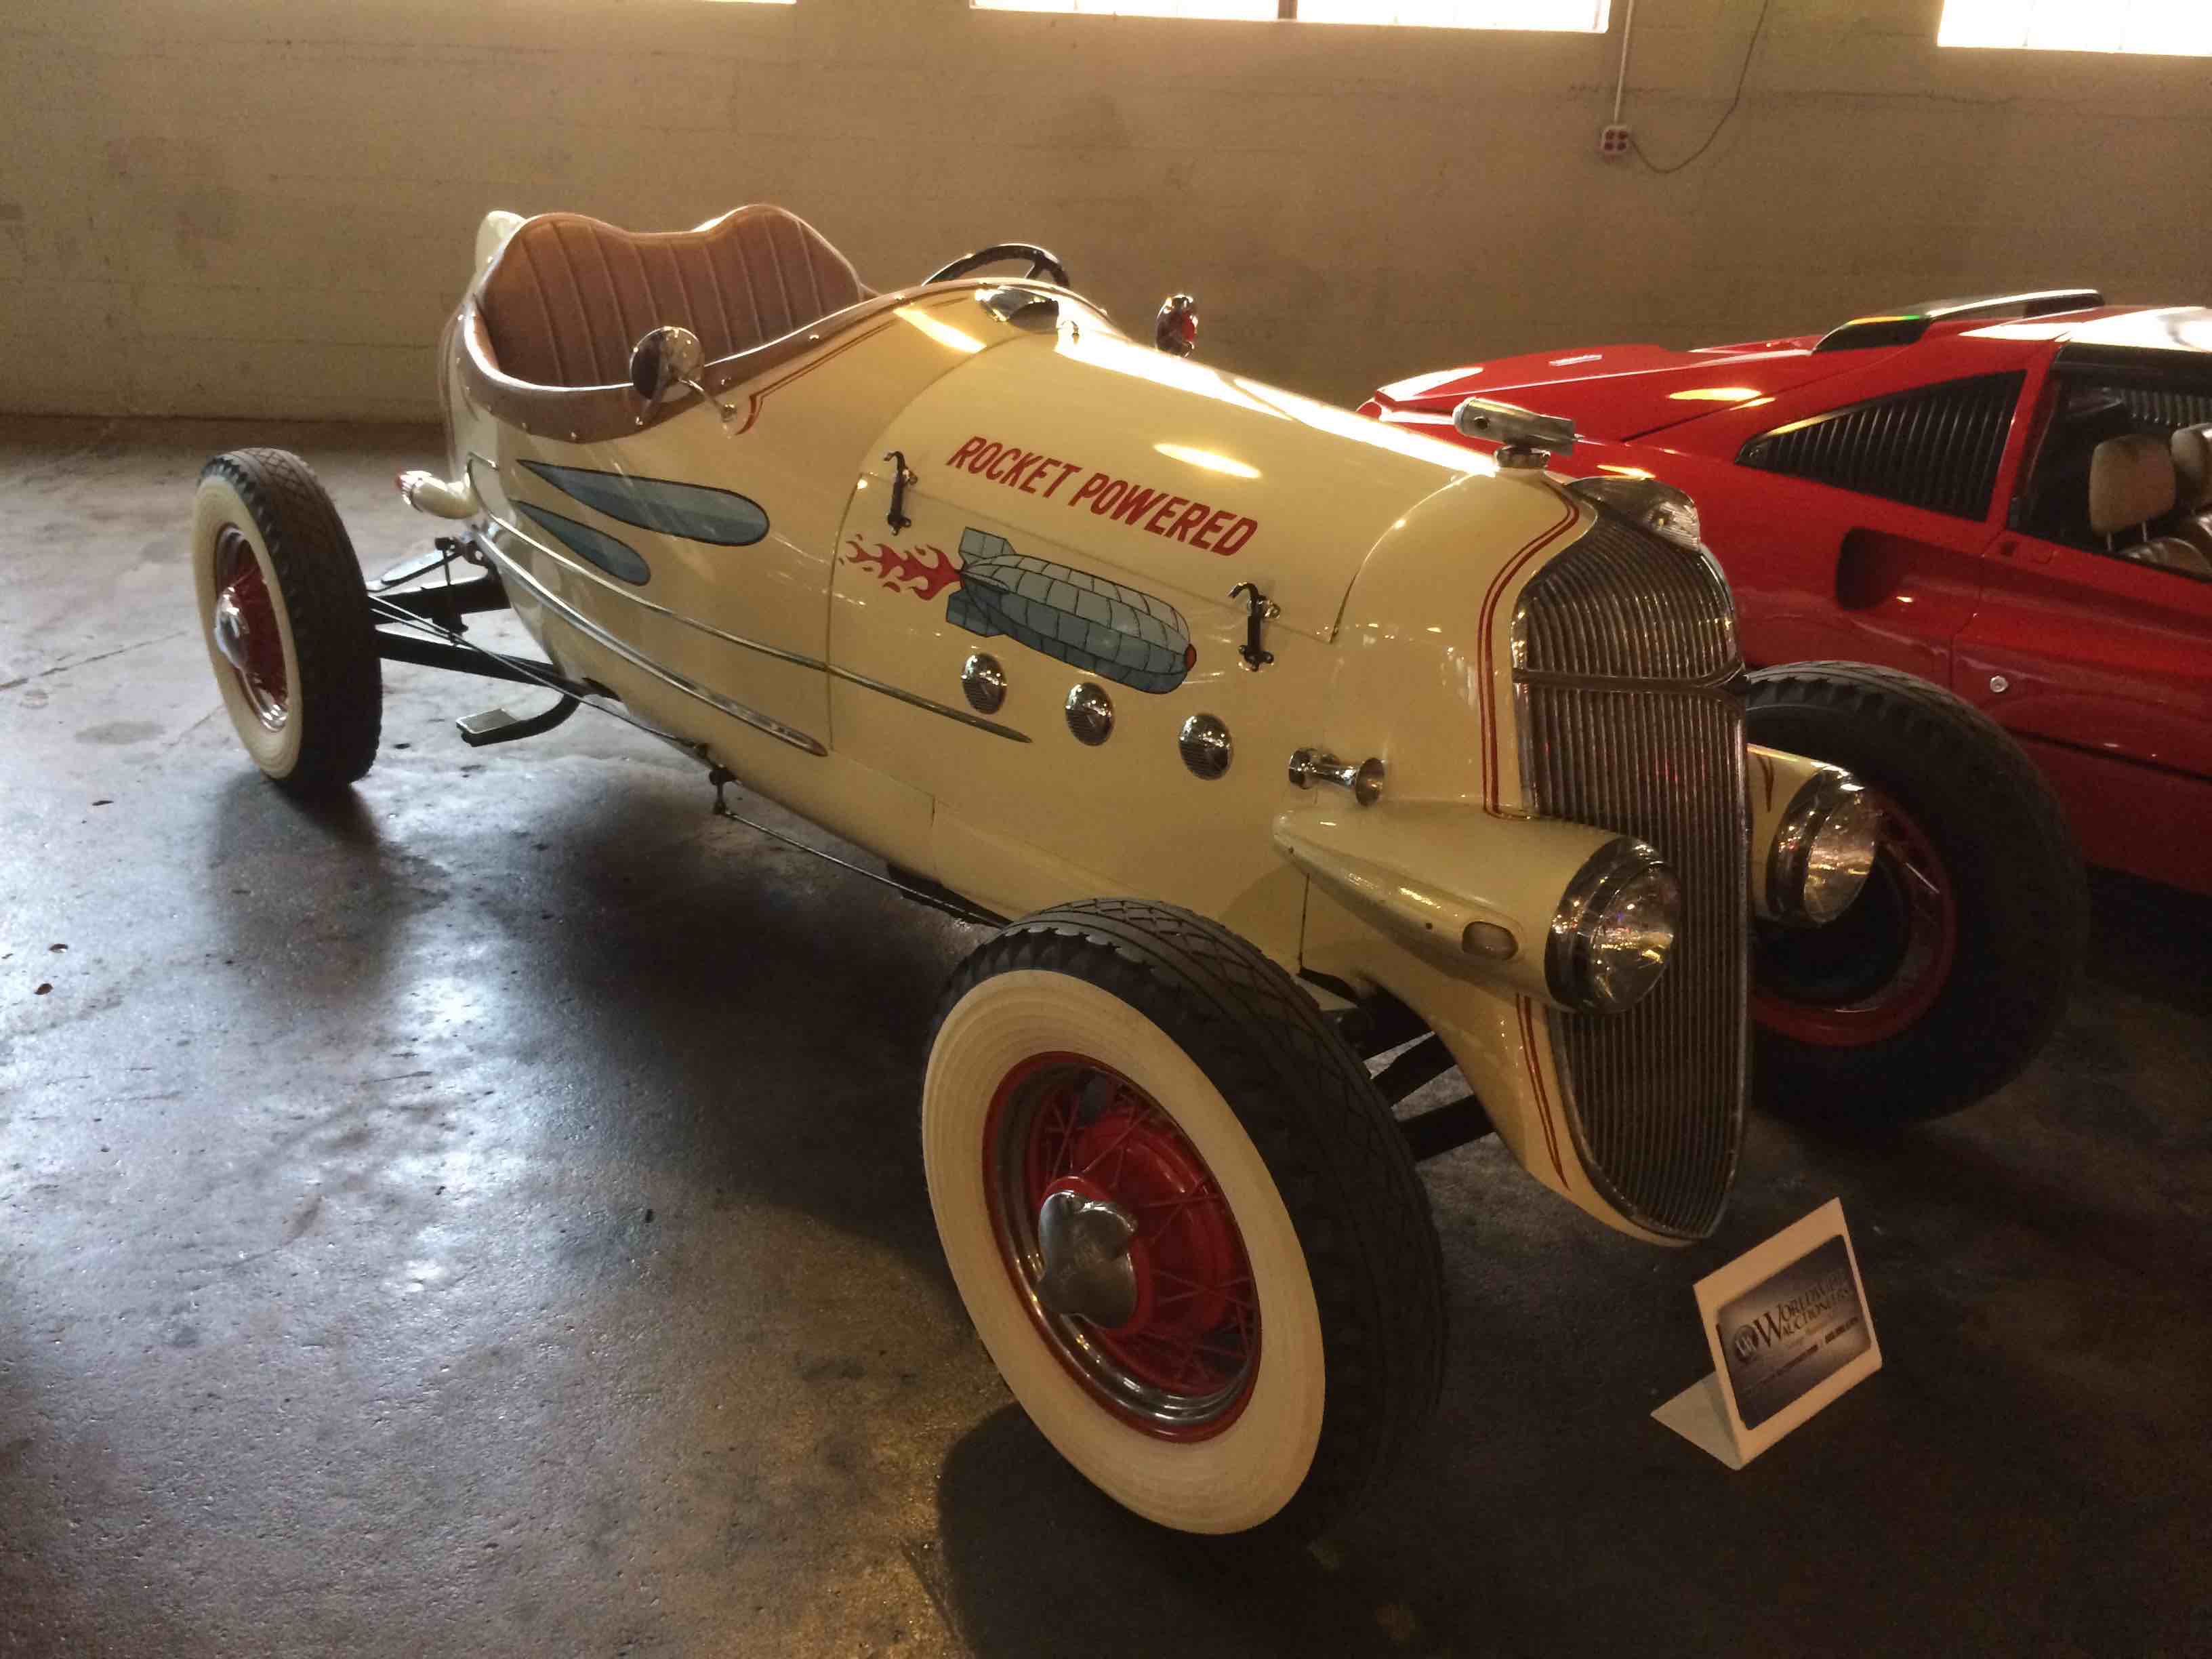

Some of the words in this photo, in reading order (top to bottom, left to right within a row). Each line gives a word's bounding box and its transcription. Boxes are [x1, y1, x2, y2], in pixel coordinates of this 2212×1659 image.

[946, 436, 1082, 499] ROCKET
[1067, 472, 1258, 557] POWERED
[1782, 1288, 1855, 1335] AUCTION
